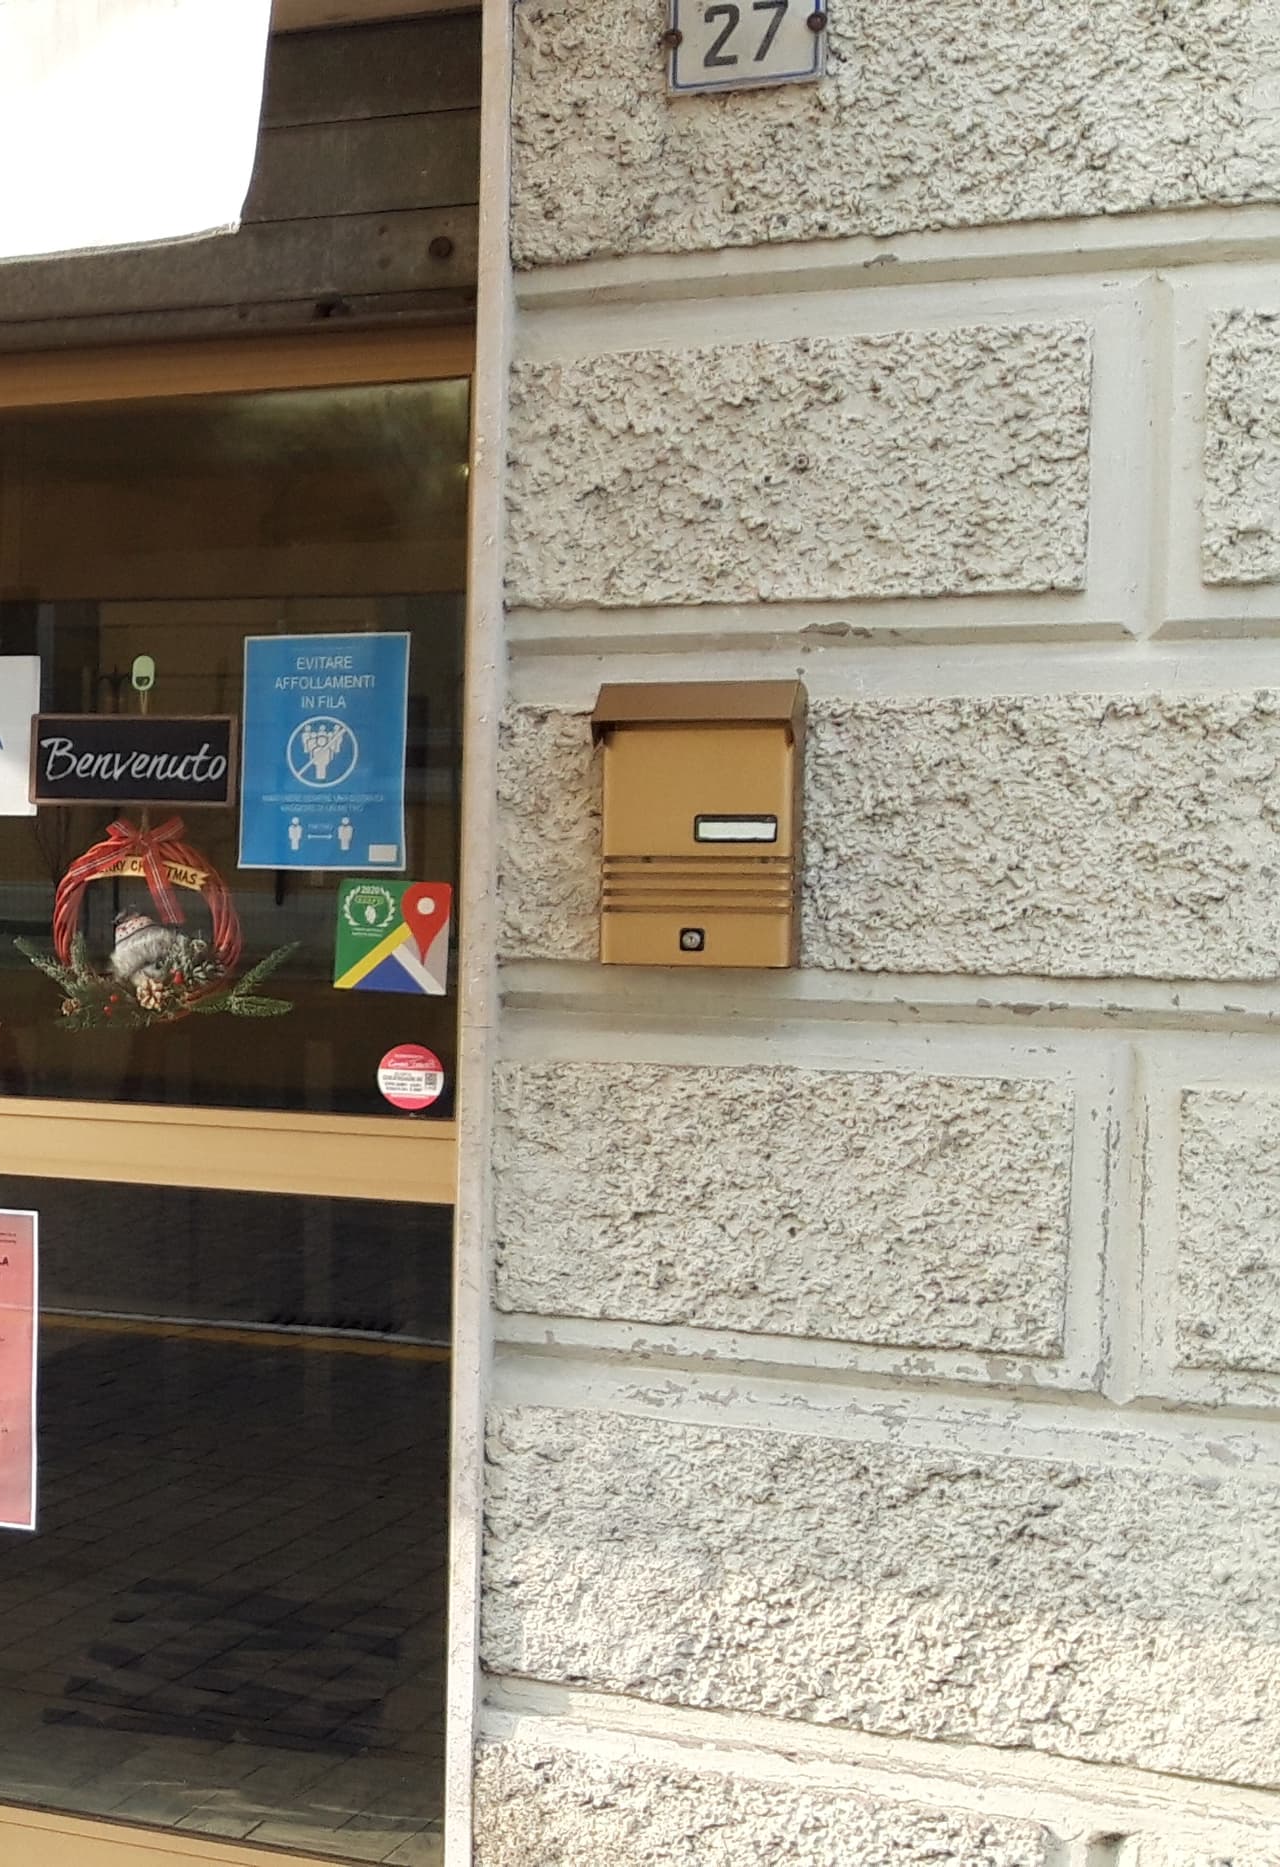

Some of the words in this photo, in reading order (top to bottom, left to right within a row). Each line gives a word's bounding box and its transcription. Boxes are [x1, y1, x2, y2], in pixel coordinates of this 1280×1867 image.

[704, 0, 788, 67] 27
[296, 655, 353, 670] EVITARE
[275, 674, 376, 689] AFFOLLAMENTI
[301, 695, 314, 709] IN
[318, 695, 347, 709] FILA
[40, 737, 227, 782] Benvenuto
